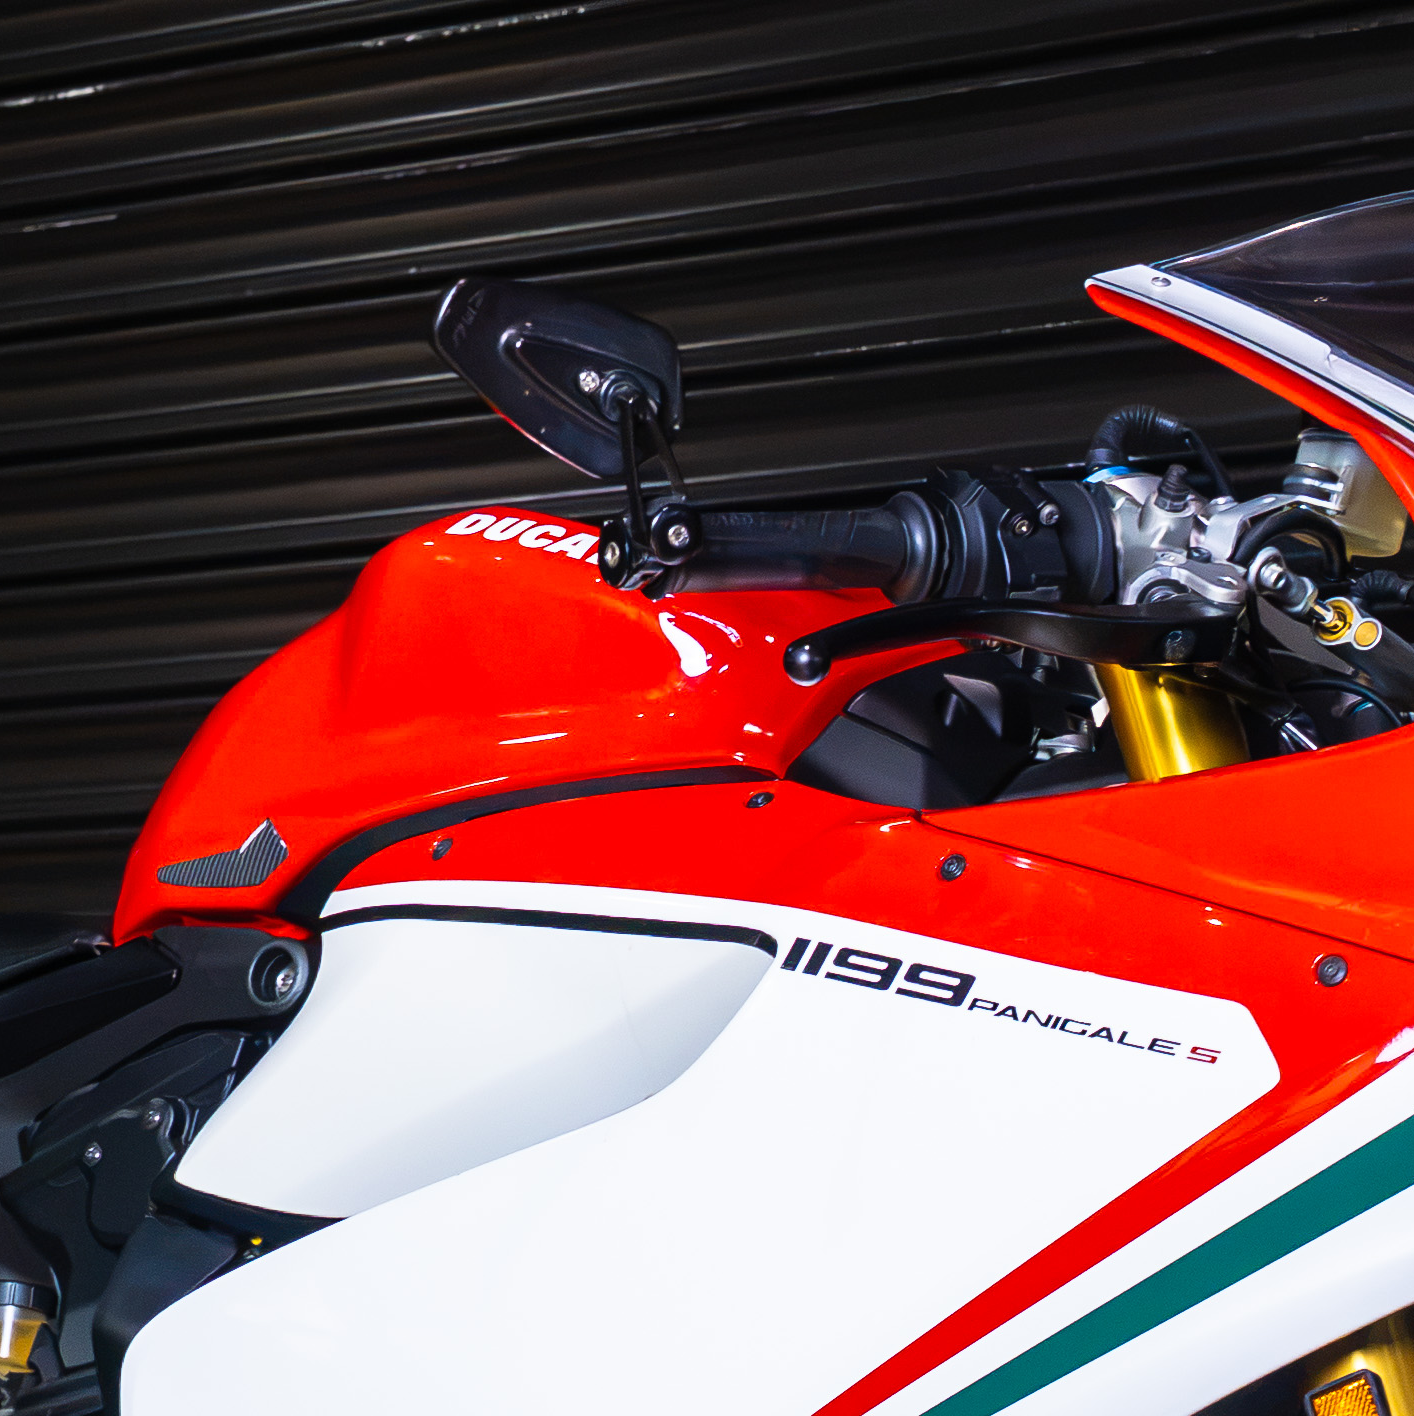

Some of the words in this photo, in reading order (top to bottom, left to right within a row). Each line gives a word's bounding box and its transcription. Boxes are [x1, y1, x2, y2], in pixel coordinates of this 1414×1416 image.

[444, 513, 600, 565] DUCA
[780, 936, 976, 1007] 1199
[967, 998, 1181, 1056] PANIGALE
[1187, 1046, 1222, 1064] S
